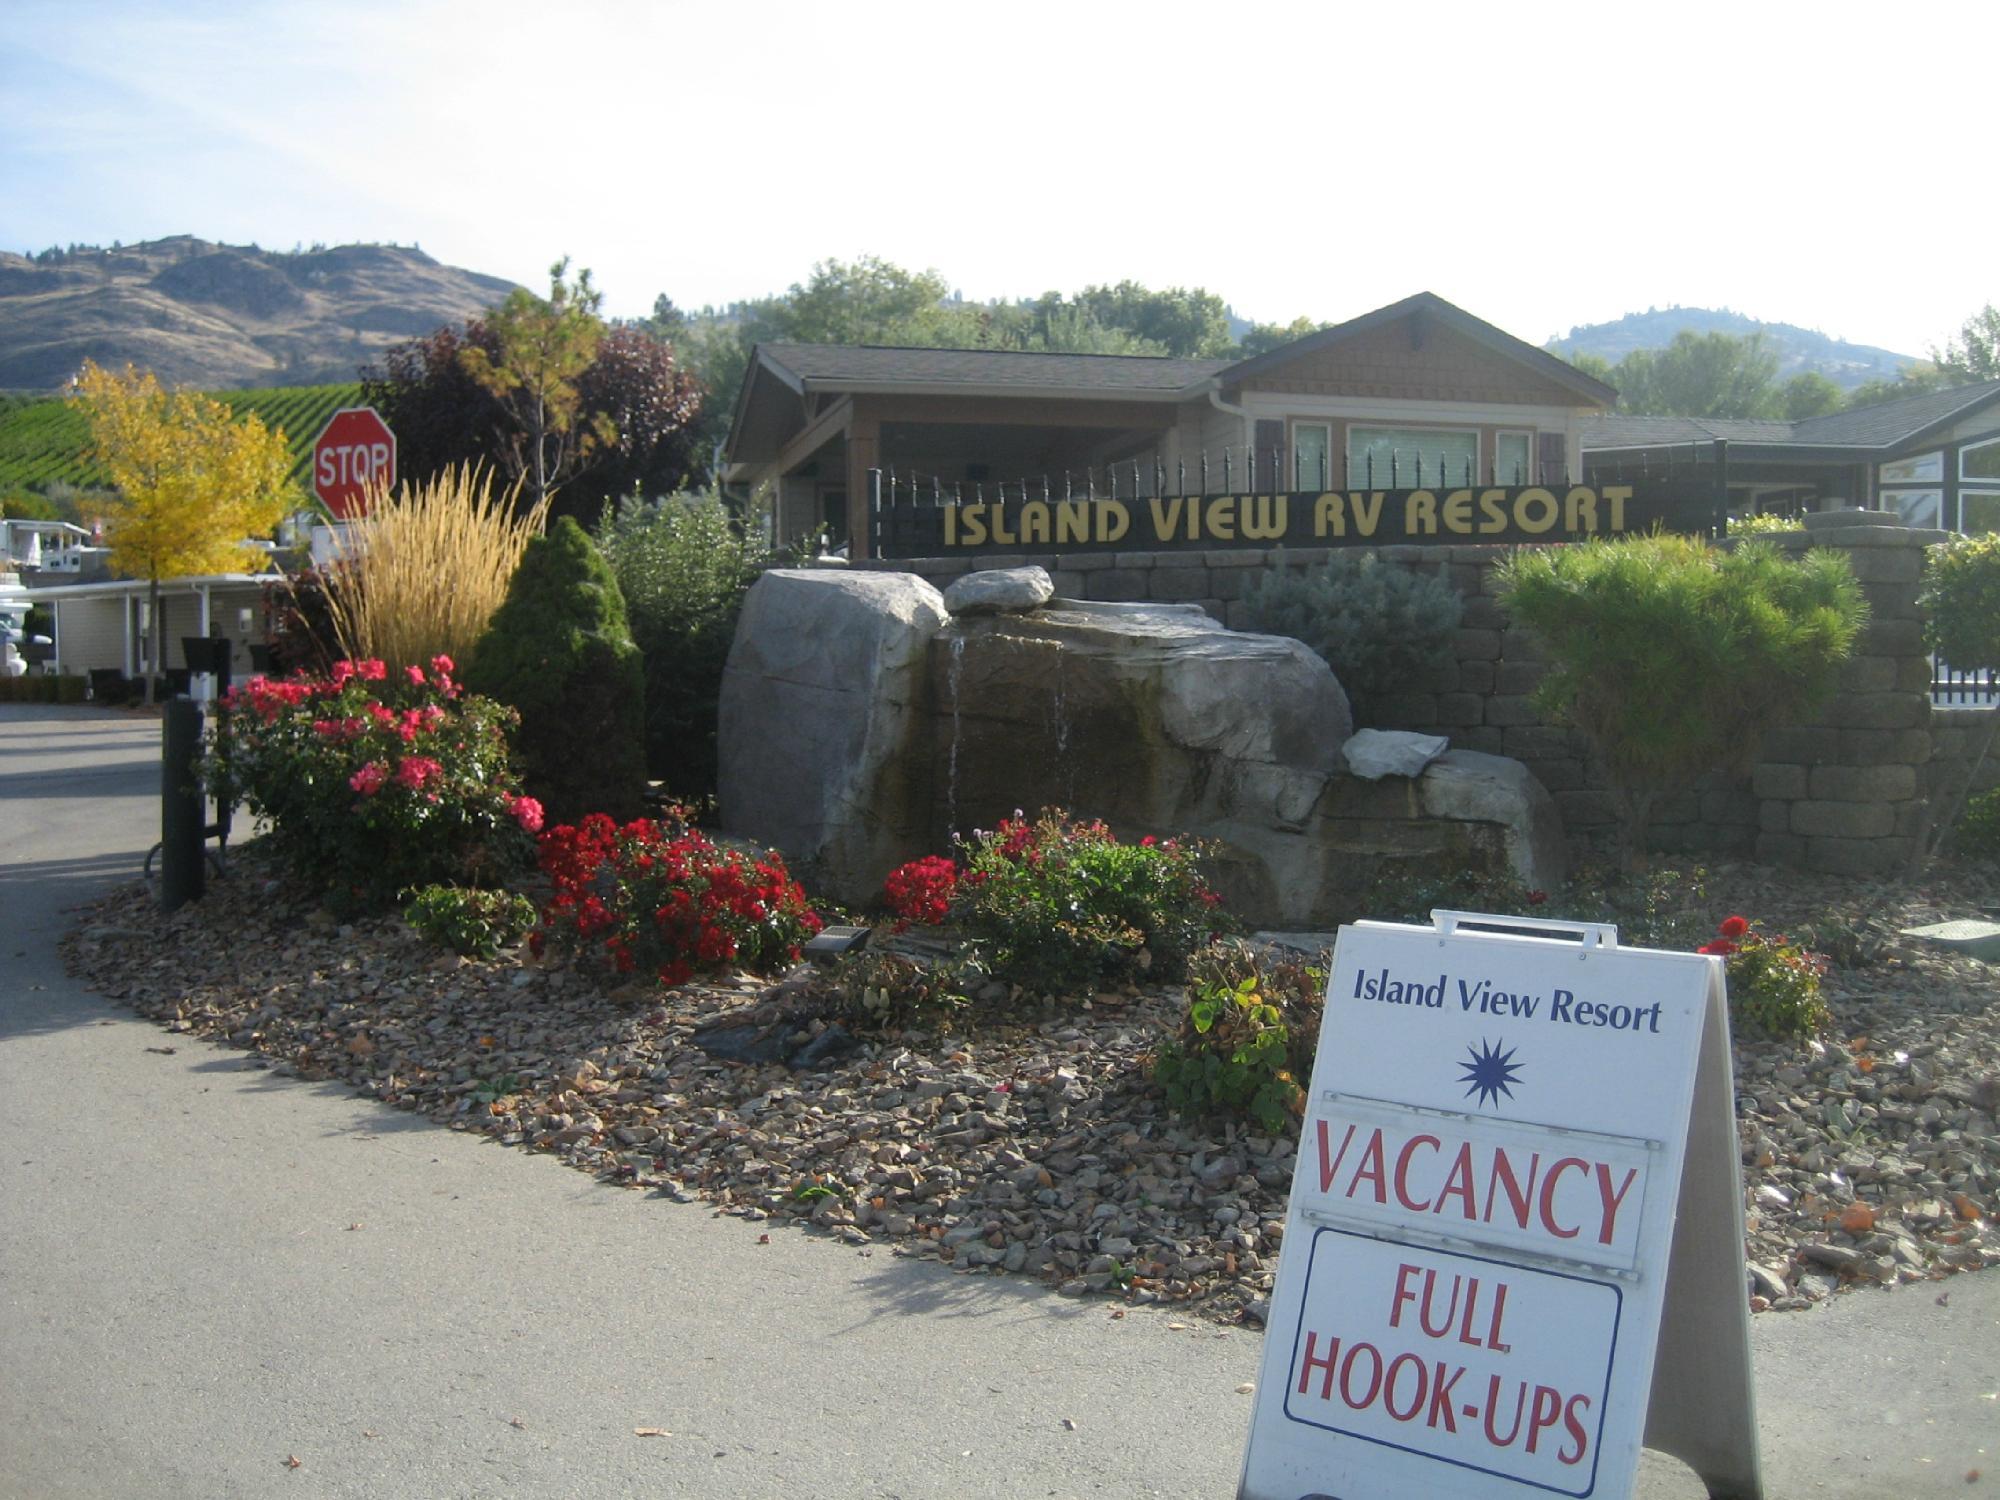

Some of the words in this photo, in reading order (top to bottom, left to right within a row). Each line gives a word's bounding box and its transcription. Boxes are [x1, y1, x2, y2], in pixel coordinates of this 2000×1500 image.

[319, 443, 389, 487] STOP
[944, 500, 1130, 545] ISLAND
[1150, 496, 1288, 542] VIEW
[1314, 491, 1386, 537] RV
[1405, 485, 1634, 535] RESORT
[1353, 968, 1448, 1008] Island
[1457, 979, 1540, 1018] View
[1550, 988, 1663, 1033] Resort
[1315, 1119, 1638, 1246] VACANCY
[1388, 1262, 1512, 1353] FULL
[1297, 1330, 1591, 1466] HOOK-UPS
